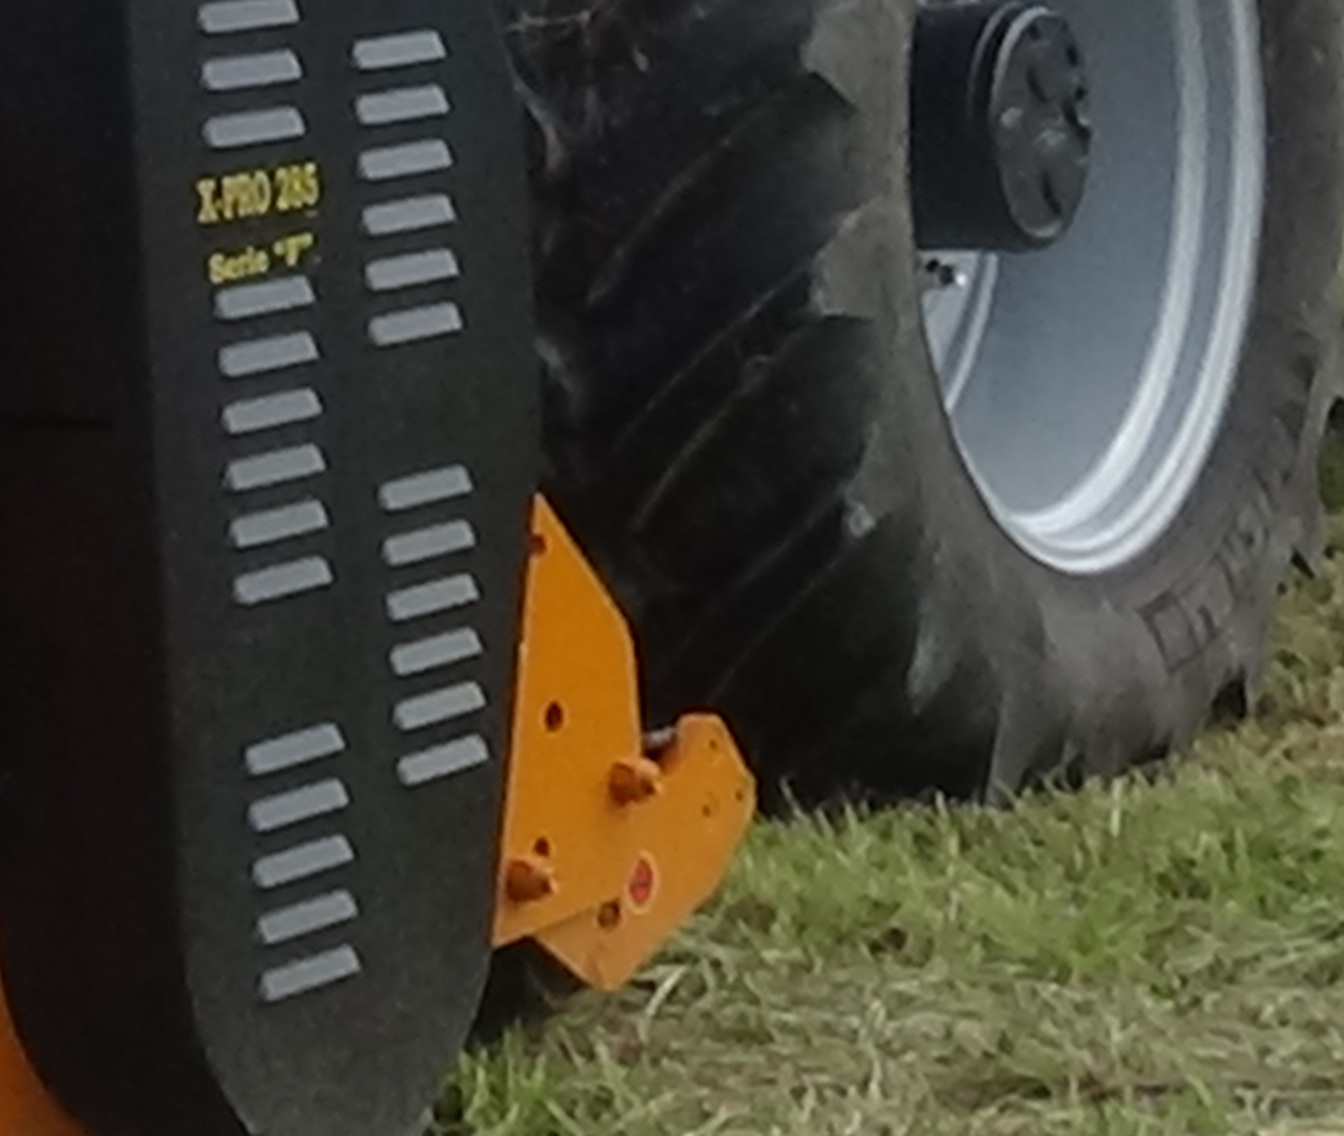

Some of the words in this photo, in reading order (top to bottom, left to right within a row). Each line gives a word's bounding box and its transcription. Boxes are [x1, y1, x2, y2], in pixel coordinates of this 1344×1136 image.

[197, 171, 272, 223] X-PRO
[275, 162, 320, 210] 285
[208, 246, 270, 284] Serie
